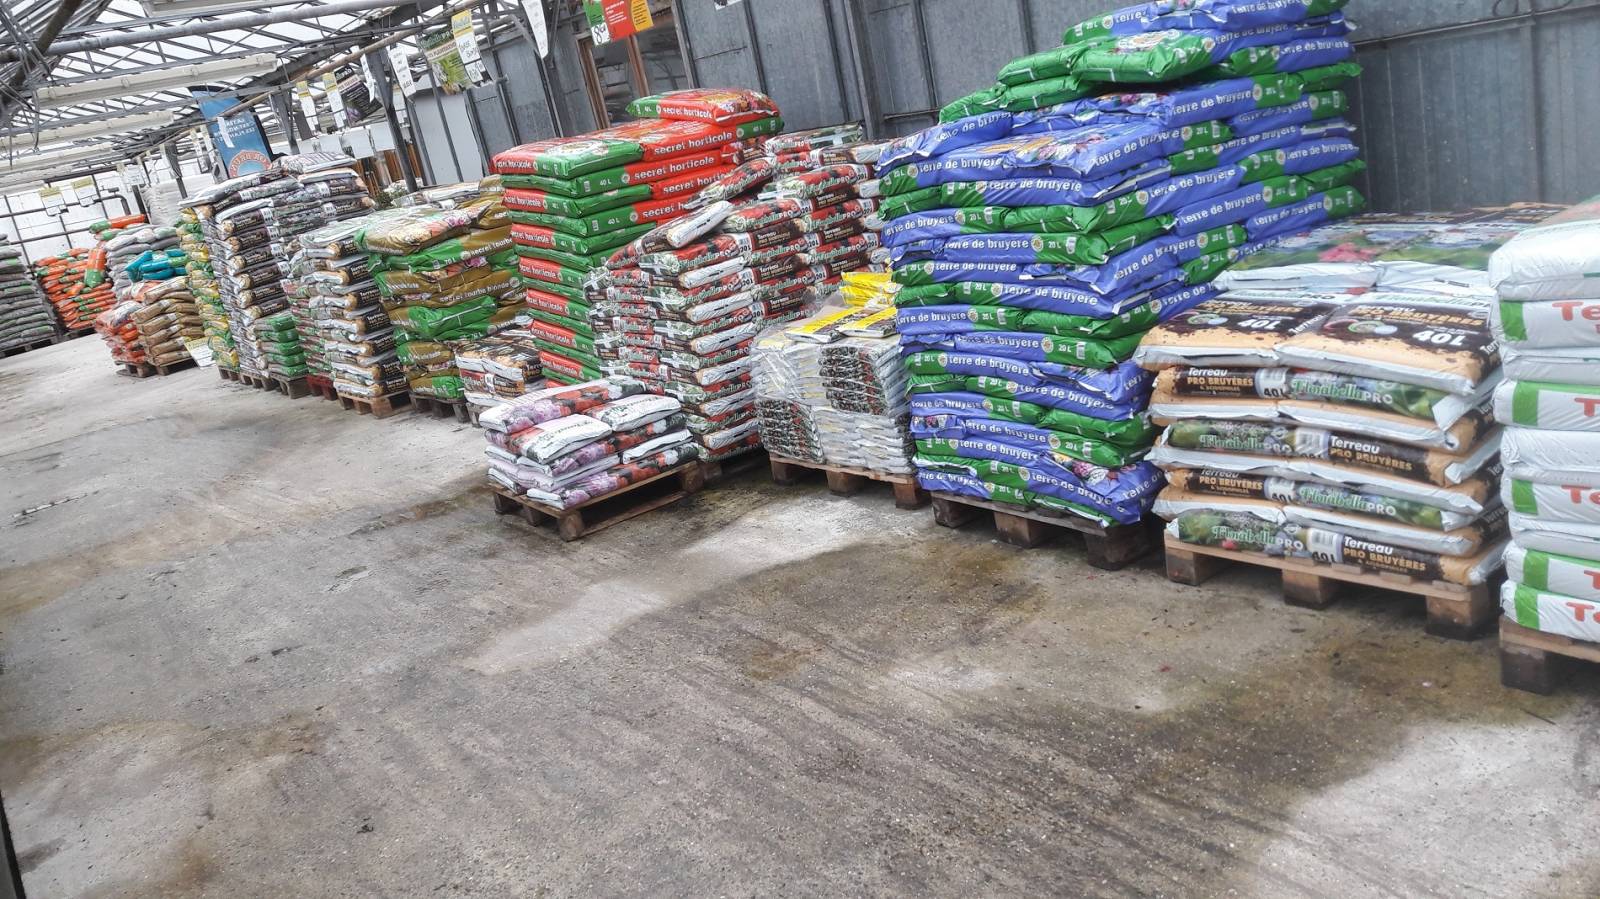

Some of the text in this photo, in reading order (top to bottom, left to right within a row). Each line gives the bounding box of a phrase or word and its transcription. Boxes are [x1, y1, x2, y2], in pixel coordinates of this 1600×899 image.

[1201, 98, 1215, 109] de
[962, 122, 976, 133] de
[654, 131, 733, 156] secret horticole
[1123, 142, 1137, 153] de
[634, 165, 666, 181] secret
[669, 155, 715, 173] horticole
[945, 157, 958, 169] de
[663, 179, 695, 194] secret
[1179, 178, 1193, 188] de
[642, 204, 675, 219] secret
[1211, 205, 1223, 214] de
[905, 219, 916, 230] de
[972, 238, 984, 249] de
[1141, 254, 1154, 265] de
[1035, 286, 1048, 296] de
[1192, 285, 1206, 296] de
[918, 312, 929, 322] de
[949, 356, 972, 365] terre
[975, 357, 987, 367] de
[1188, 367, 1228, 377] Terreau
[1187, 377, 1206, 386] PRO
[1051, 387, 1065, 399] de
[989, 422, 1002, 433] de
[959, 440, 983, 450] terre
[986, 442, 997, 452] de
[1331, 435, 1381, 454] Terreau
[1330, 448, 1353, 459] PRO
[1060, 480, 1074, 491] de
[1199, 475, 1217, 485] PRO
[1343, 535, 1395, 556] Terreau
[1343, 547, 1366, 560] PRO
